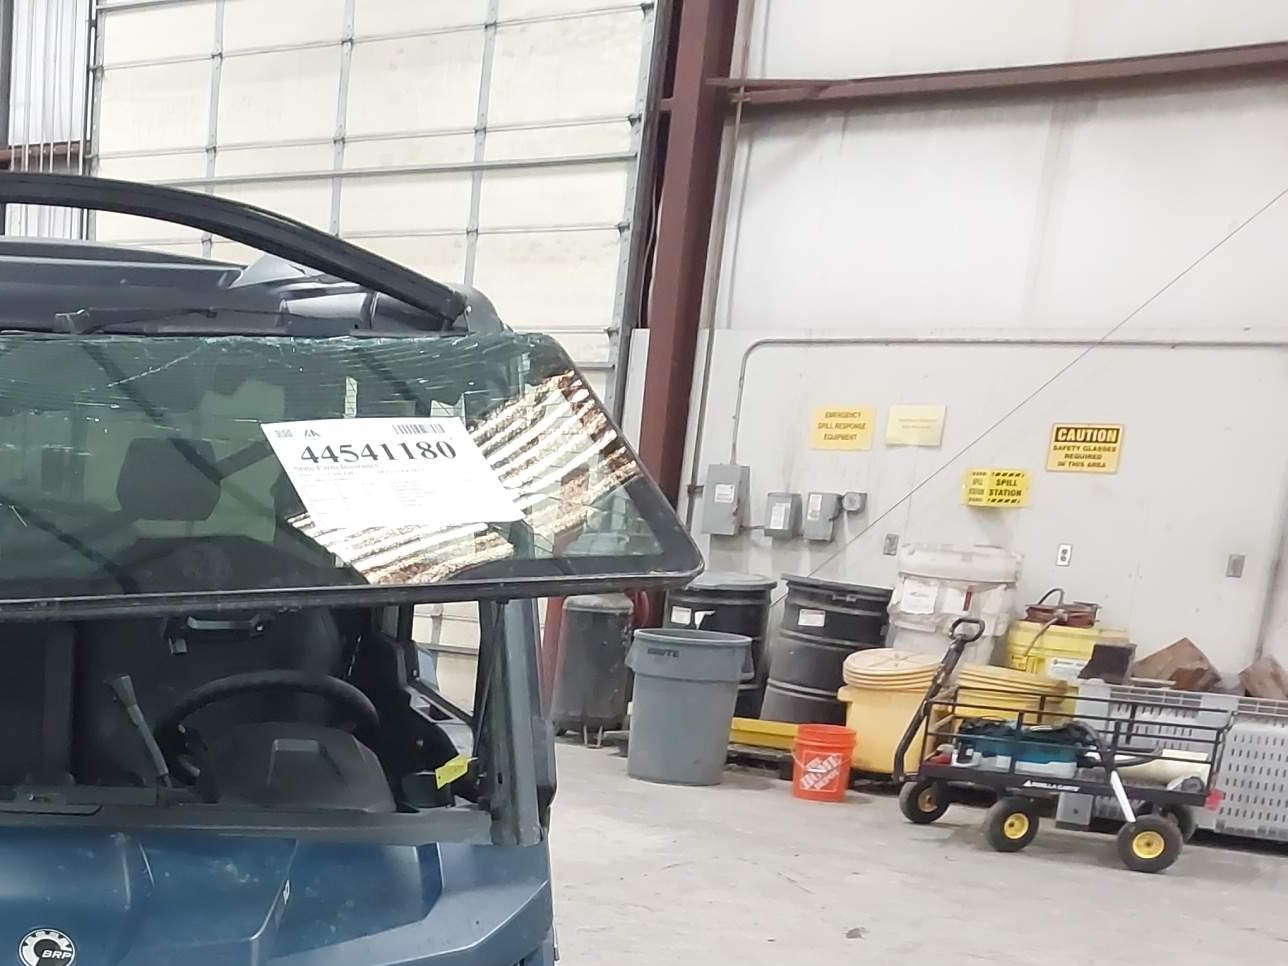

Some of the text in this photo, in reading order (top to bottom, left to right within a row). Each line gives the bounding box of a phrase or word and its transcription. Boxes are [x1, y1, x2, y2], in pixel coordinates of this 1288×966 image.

[1057, 428, 1117, 442] CAUTION
[301, 441, 457, 463] 44541180
[996, 479, 1017, 487] SPILL
[989, 488, 1022, 497] STATION
[42, 949, 73, 959] BRP
